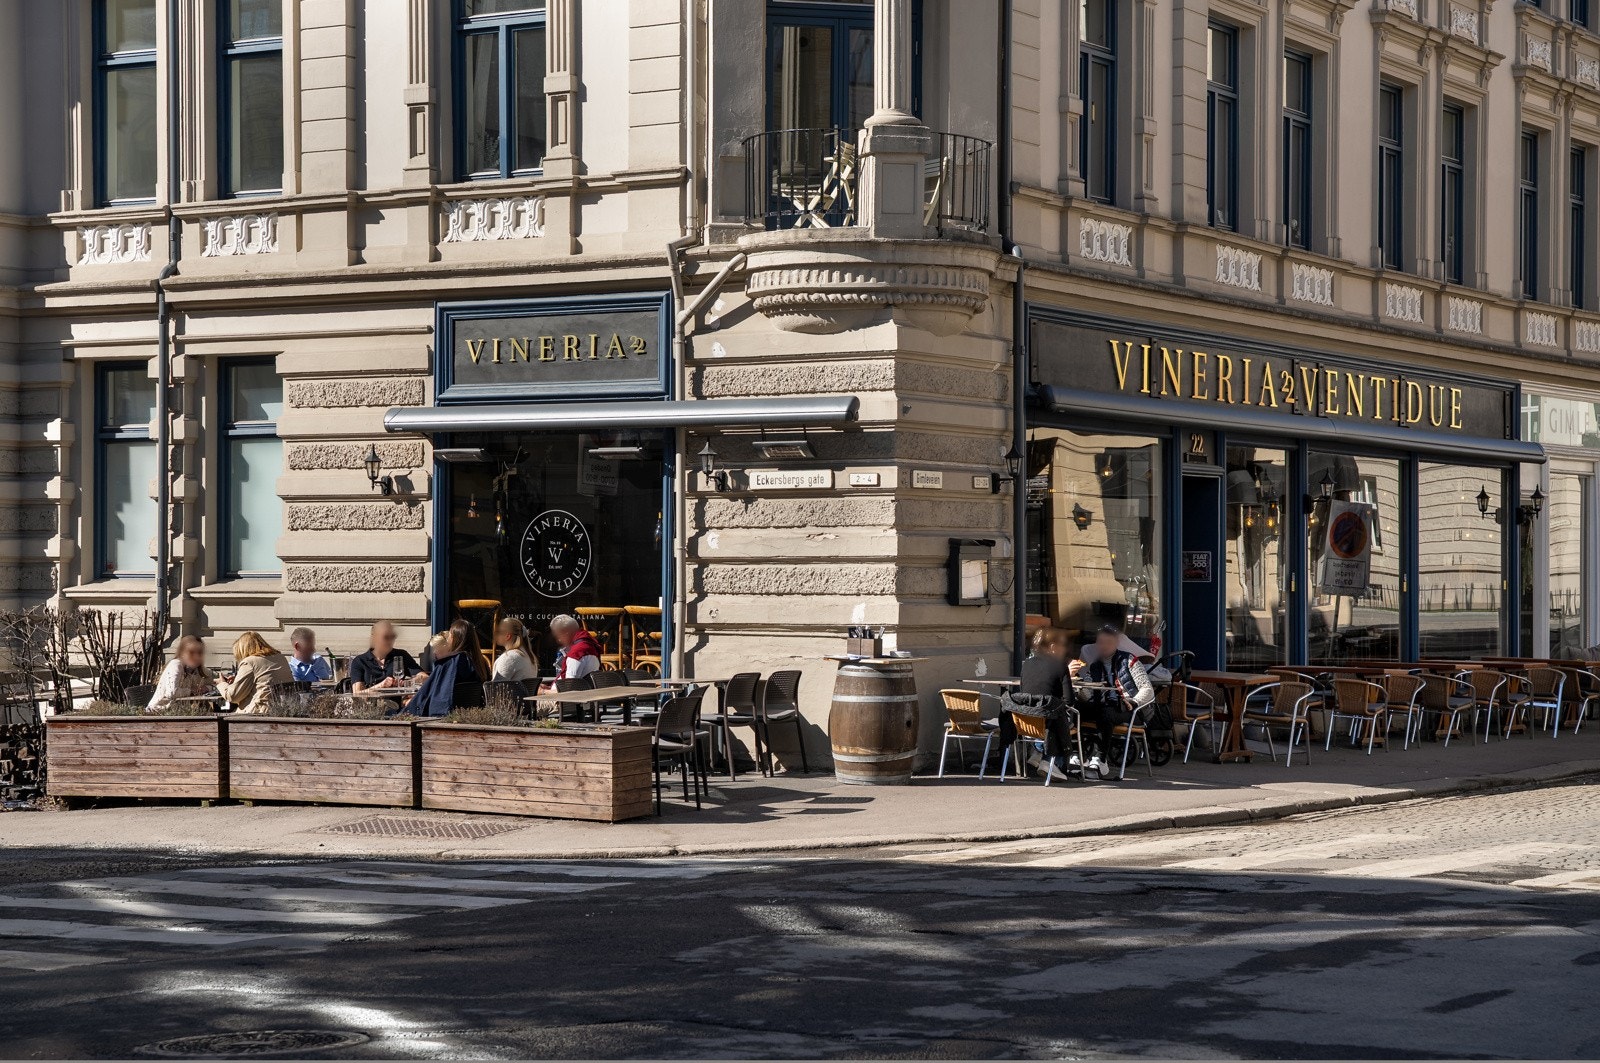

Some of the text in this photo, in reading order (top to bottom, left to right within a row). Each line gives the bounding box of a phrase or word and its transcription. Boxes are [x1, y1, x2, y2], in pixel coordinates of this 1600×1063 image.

[465, 332, 627, 364] VINERIA
[1109, 339, 1279, 408] VINERIA
[1300, 366, 1463, 429] VENTIDUE
[1191, 433, 1204, 453] 22
[756, 474, 825, 487] Eckersbergs gate
[525, 516, 584, 543] VINERIA
[525, 557, 587, 592] VENTIDUE
[1192, 560, 1207, 568] 500
